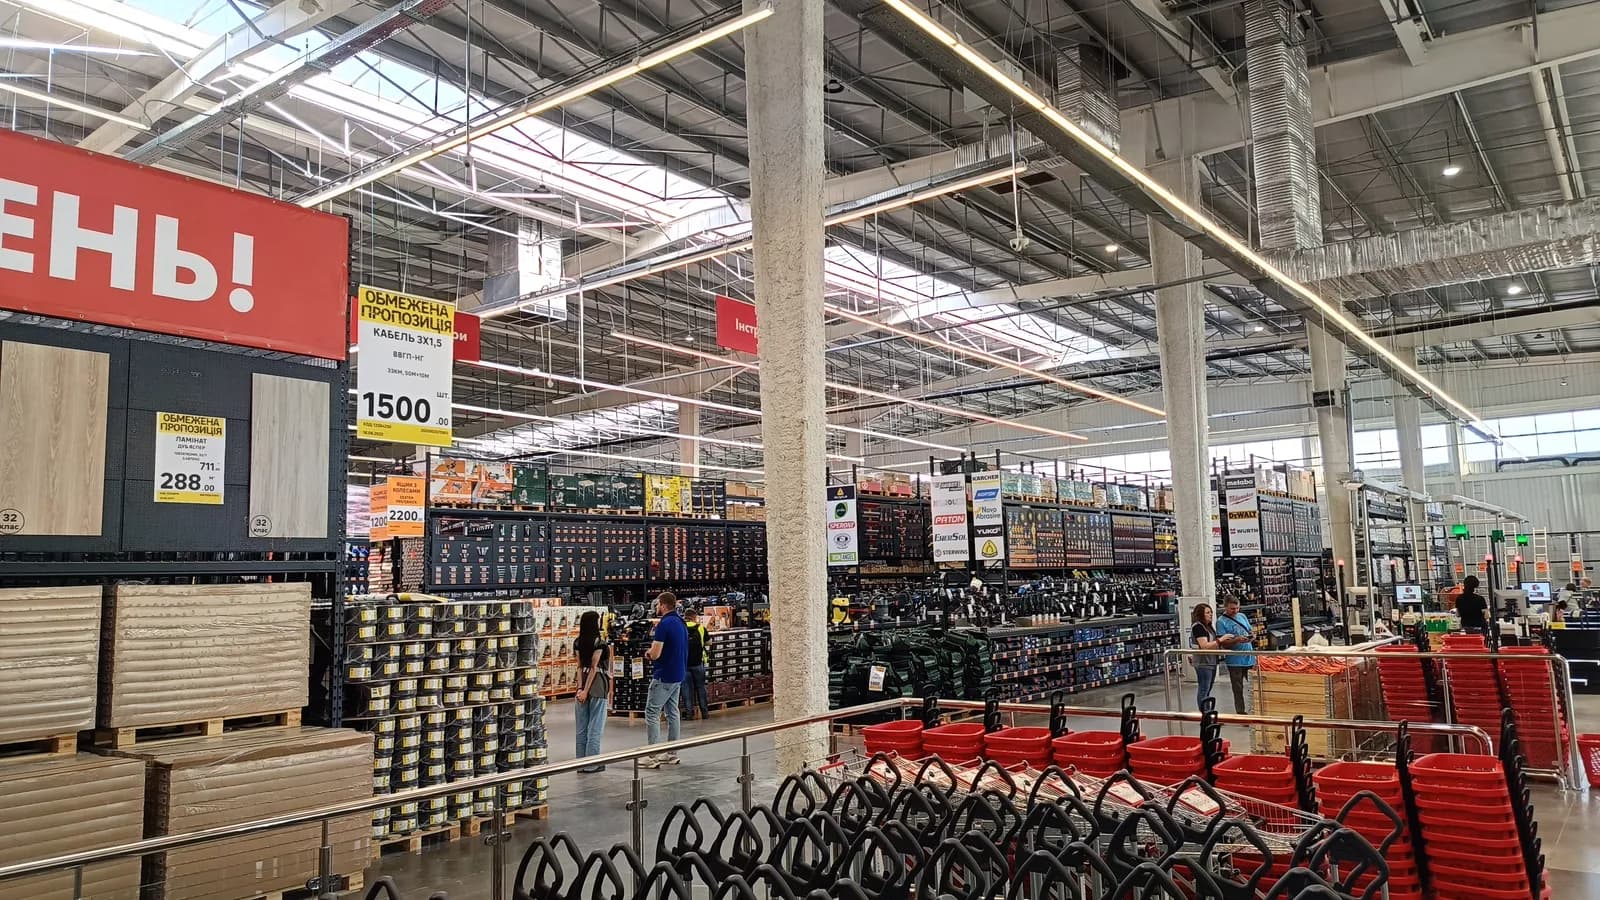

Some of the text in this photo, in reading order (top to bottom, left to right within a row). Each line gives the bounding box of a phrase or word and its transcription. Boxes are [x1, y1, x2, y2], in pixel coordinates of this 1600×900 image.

[0, 178, 254, 312] ЕНЬ!
[365, 290, 449, 318] ОБМЕЖЕНА
[361, 305, 452, 334] ПРОПОЗИЦІЯ
[373, 328, 415, 343] КАБЕЛЬ
[363, 391, 431, 423] 1500
[163, 413, 220, 426] ОБМЕЖЕНА
[160, 423, 222, 436] ПРОПОЗИЦІЯ
[176, 436, 207, 444] ЛАМІНАТ
[200, 462, 214, 471] 711
[160, 472, 201, 491] 288
[2, 513, 17, 522] 32
[256, 518, 266, 526] 32
[371, 516, 388, 528] 1200
[389, 510, 418, 521] 2200
[935, 514, 965, 524] PATON
